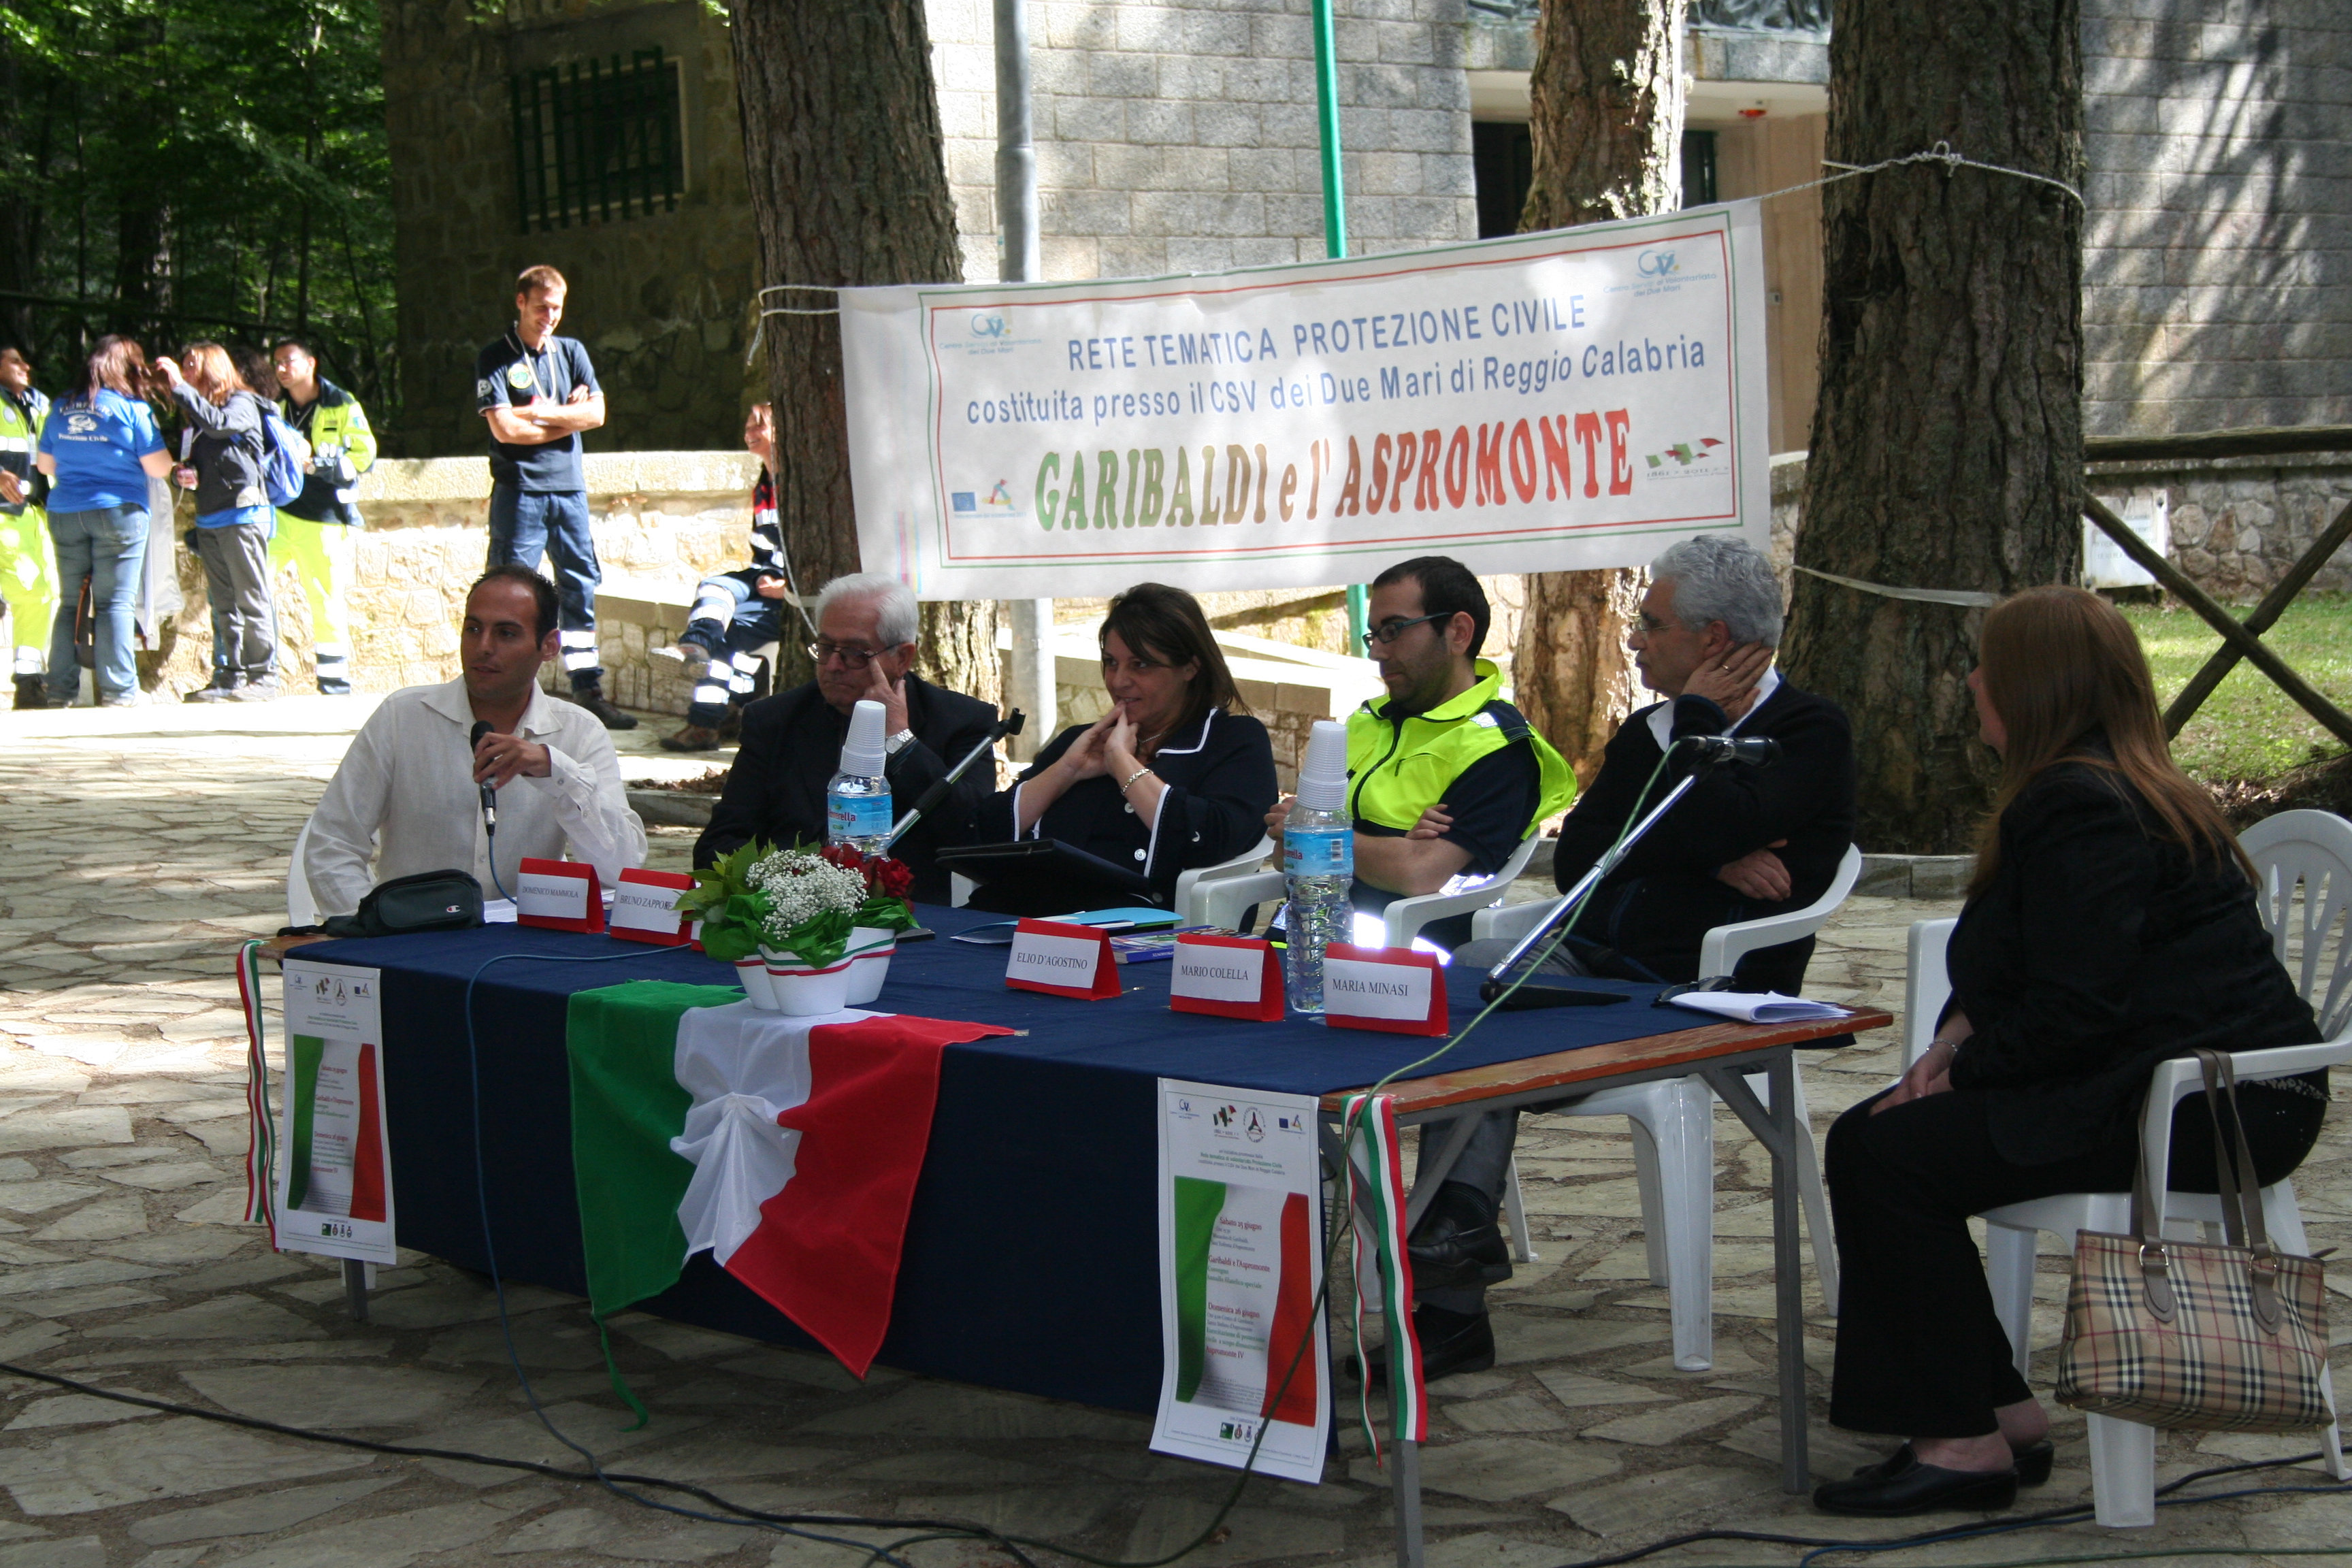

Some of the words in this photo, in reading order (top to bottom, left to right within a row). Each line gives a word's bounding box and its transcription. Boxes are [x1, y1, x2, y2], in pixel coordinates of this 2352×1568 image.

[1665, 273, 1717, 284] Volontariato
[1646, 287, 1661, 295] Due
[1663, 284, 1681, 293] Mari
[1068, 336, 1137, 372] RETE
[1143, 327, 1277, 367] TEMATICA
[1292, 305, 1482, 357] PROTEZIONE
[1490, 294, 1586, 338] CIVILE
[966, 389, 1084, 425] costituita
[1093, 388, 1181, 427] presso
[1190, 382, 1204, 414] il
[1209, 379, 1257, 414] CSV
[1269, 372, 1313, 410] dei
[1321, 372, 1371, 406] Due
[1379, 361, 1441, 401] Mari
[1450, 356, 1474, 394] di
[1482, 354, 1572, 396] Reggio
[1581, 333, 1705, 379] Calabria
[1034, 443, 1268, 532] GARIBALDI
[1278, 463, 1297, 523] e
[1334, 408, 1633, 518] ASPROMONTE
[522, 886, 549, 896] DOMENICO
[550, 887, 578, 898] MAMMOLA
[620, 894, 642, 906] BRUNO
[642, 897, 673, 911] ZAPPONE
[1017, 952, 1037, 965] ELIO
[1037, 953, 1088, 970] D'AGOSTINO
[1181, 964, 1209, 978] MARIO
[1209, 966, 1249, 981] COLELLA
[1332, 977, 1366, 994] MARIA
[1369, 981, 1409, 997] MINASI
[1220, 1216, 1237, 1226] Sabato
[1244, 1221, 1262, 1231] giugno
[1208, 1255, 1232, 1266] Garibaldi
[1236, 1258, 1271, 1272] l'Aspromonte
[1208, 1302, 1234, 1314] Domenica
[1241, 1307, 1260, 1319] giugno
[1206, 1345, 1237, 1358] Aspromonte
